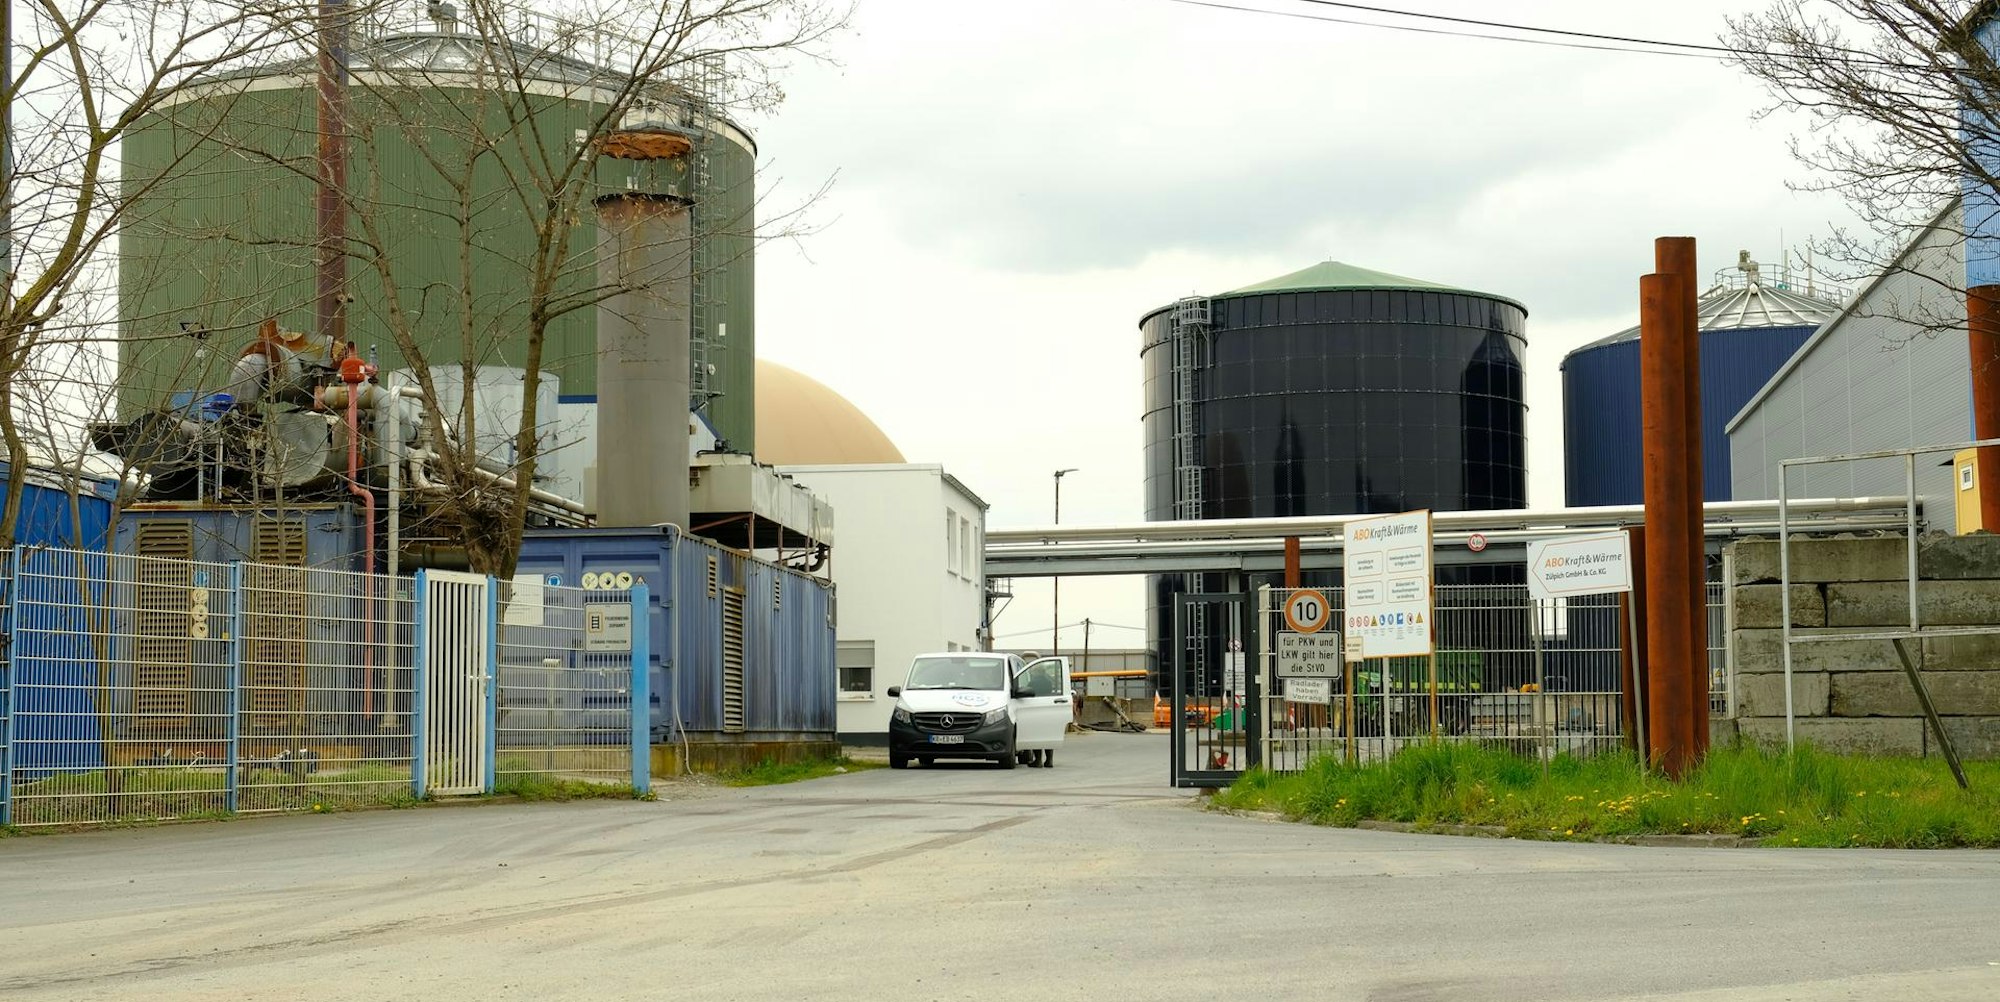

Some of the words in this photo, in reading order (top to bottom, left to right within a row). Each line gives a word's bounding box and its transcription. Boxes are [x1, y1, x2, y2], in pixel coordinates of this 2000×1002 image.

[1546, 572, 1564, 581] Zülpich
[1565, 570, 1582, 578] GmbH
[1598, 567, 1607, 575] KG
[1296, 602, 1317, 621] 10
[1283, 637, 1294, 646] für
[1299, 637, 1316, 646] PKW
[1319, 637, 1334, 646] und
[1281, 650, 1298, 660] LKW
[1302, 650, 1315, 661] gilt
[1319, 650, 1334, 660] hier
[1291, 664, 1303, 673] die
[1306, 664, 1325, 673] StVO
[1290, 680, 1323, 688] Radlader
[1296, 686, 1319, 694] haben
[1292, 693, 1323, 701] Vorrang
